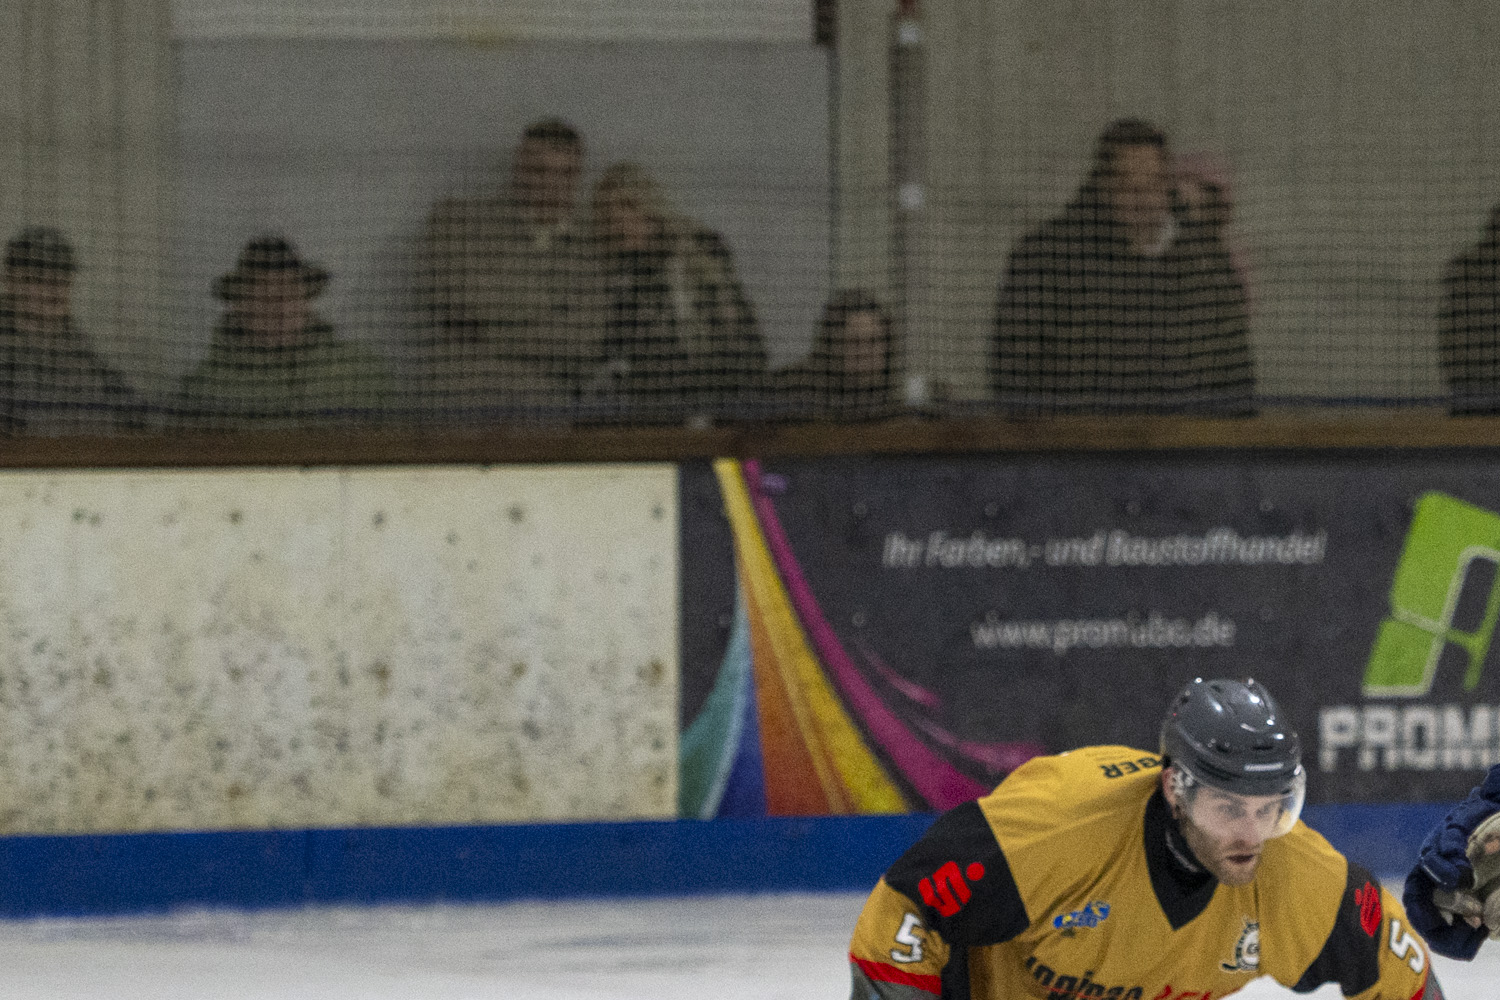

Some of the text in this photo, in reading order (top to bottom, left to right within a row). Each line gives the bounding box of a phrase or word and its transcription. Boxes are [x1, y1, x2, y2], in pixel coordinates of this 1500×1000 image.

[883, 533, 924, 567] Ihr
[1047, 531, 1104, 566] und
[1106, 528, 1329, 566] Baustoffhandel
[890, 912, 923, 964] 5
[1389, 918, 1426, 974] 5
